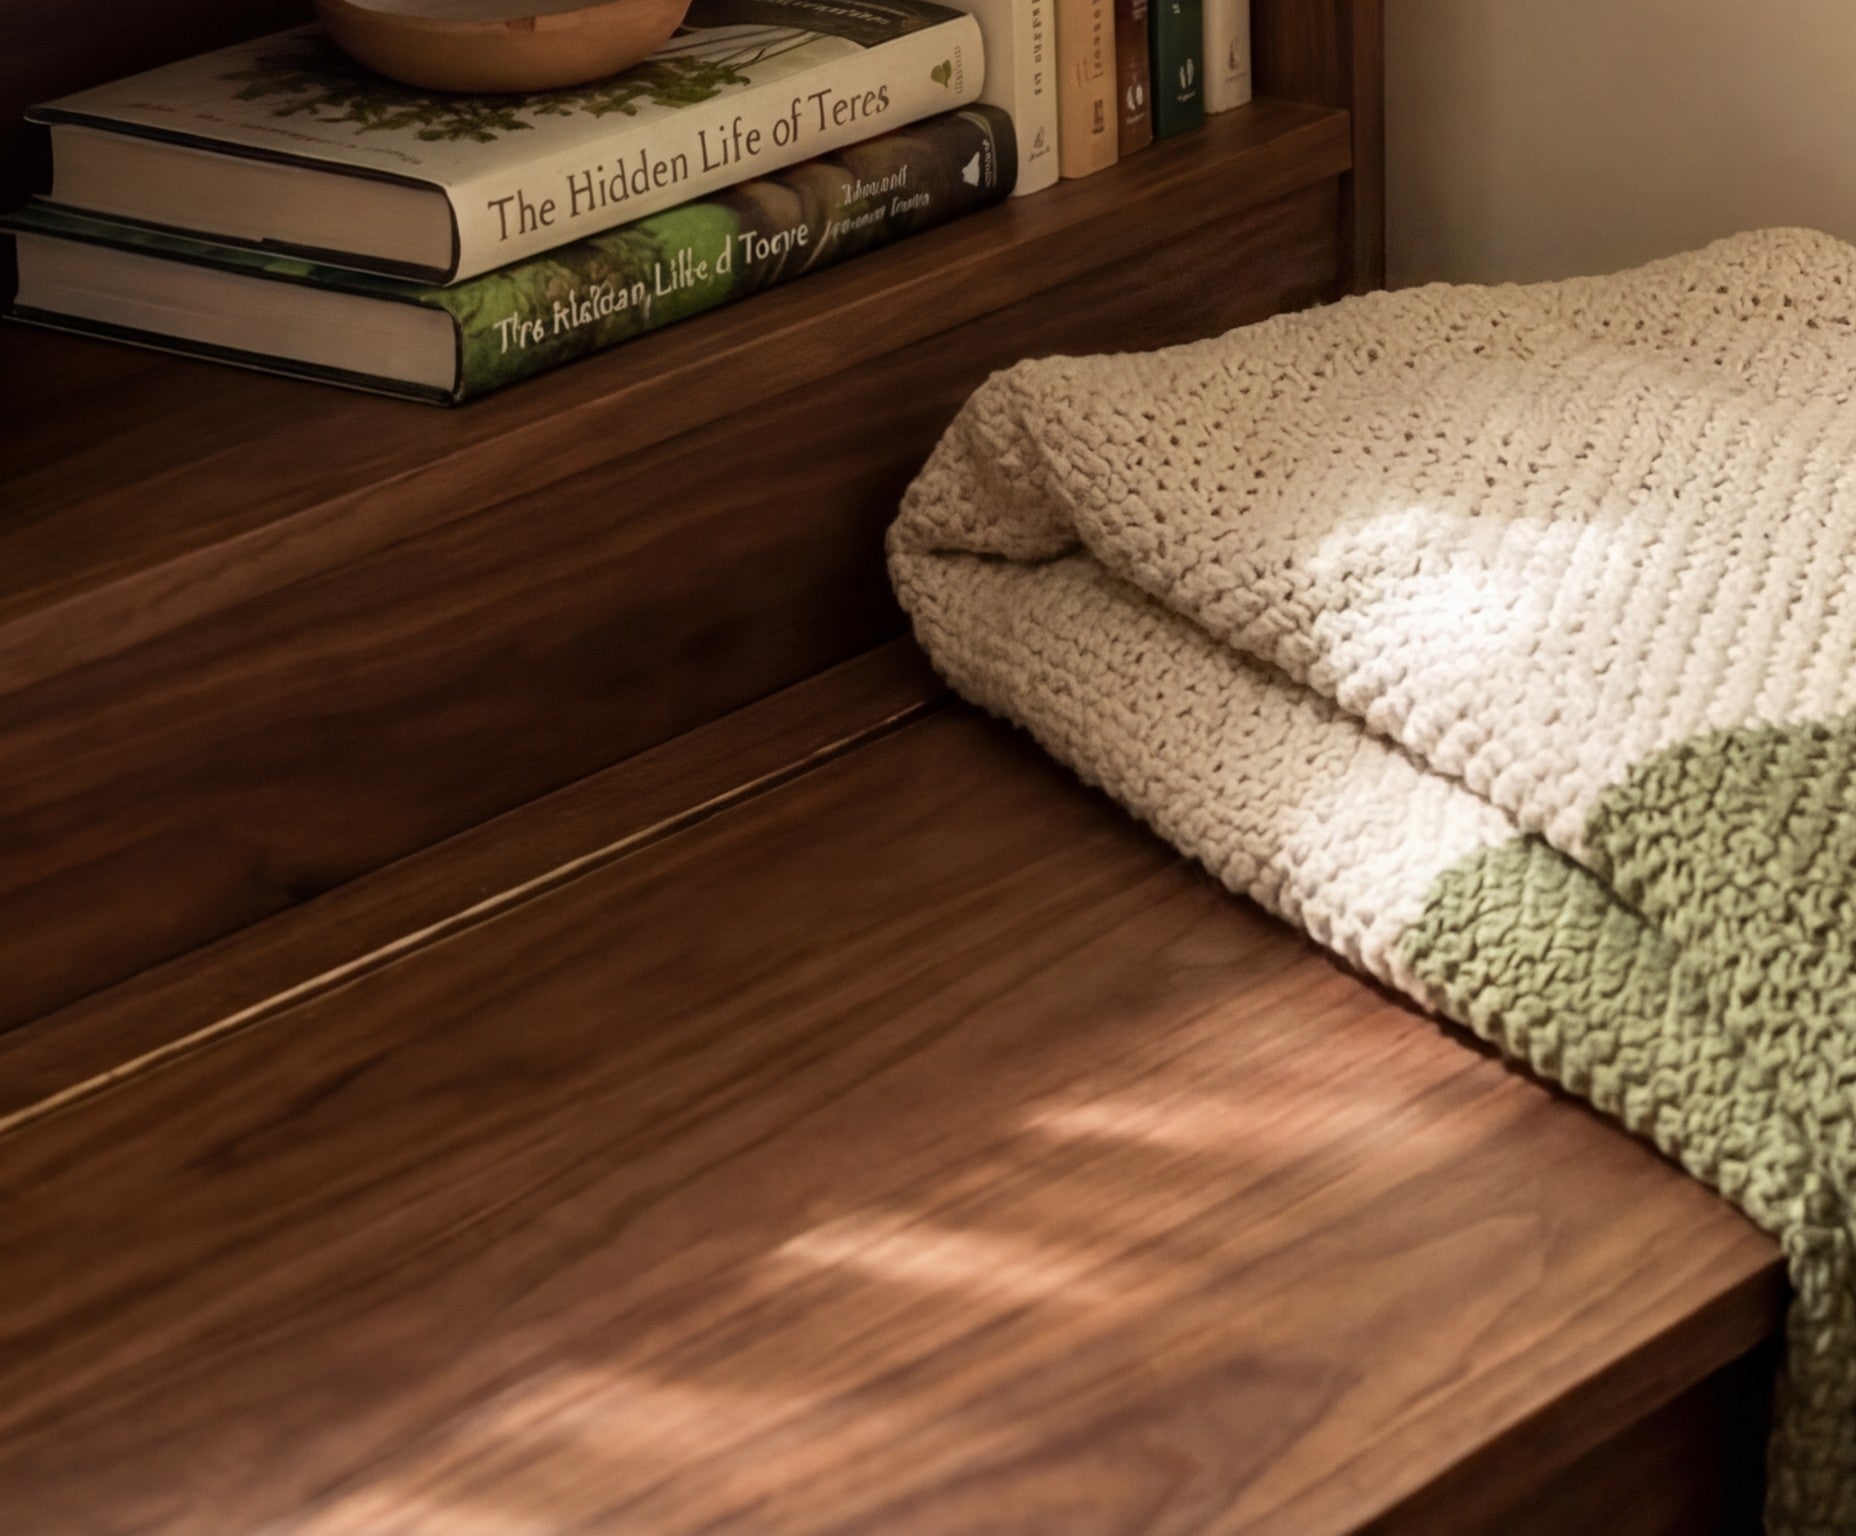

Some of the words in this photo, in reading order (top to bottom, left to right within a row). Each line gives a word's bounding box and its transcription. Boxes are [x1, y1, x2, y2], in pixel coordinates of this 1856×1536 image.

[487, 189, 556, 242] The
[566, 148, 689, 218] Hidden
[698, 116, 762, 173] Life
[772, 96, 802, 147] of
[807, 85, 890, 132] Teres
